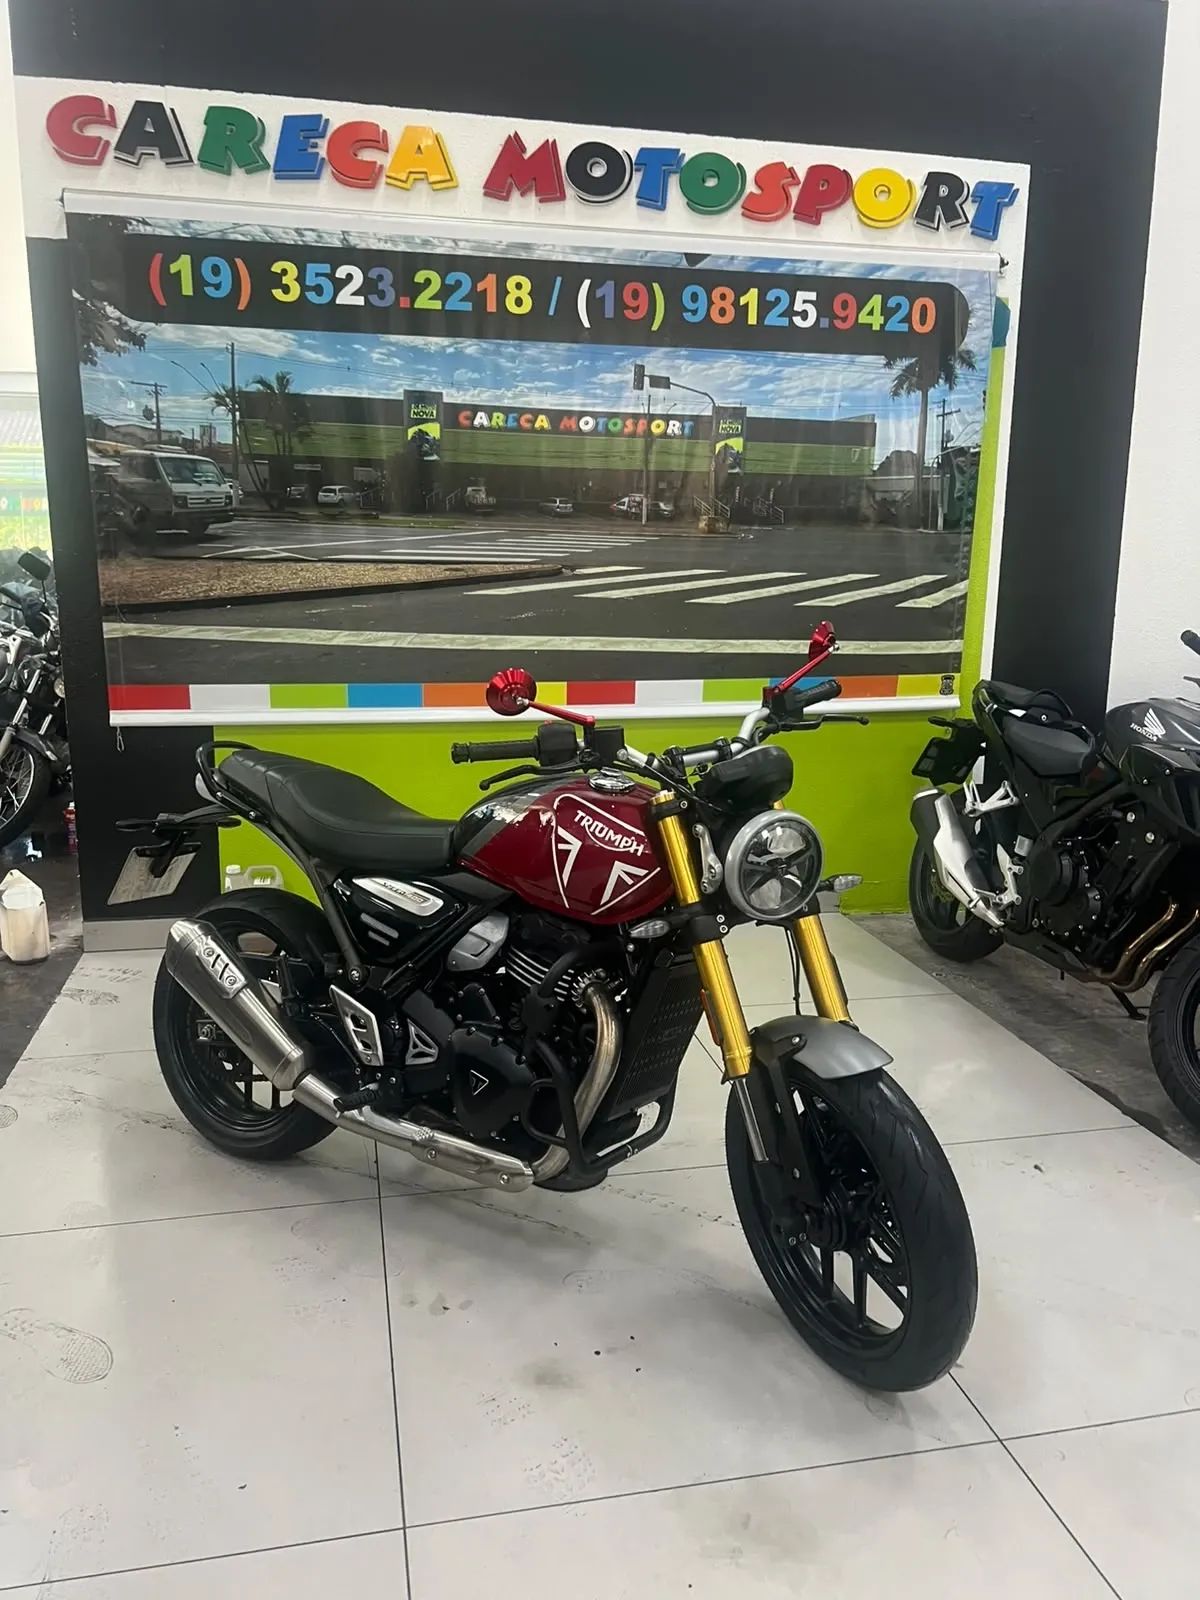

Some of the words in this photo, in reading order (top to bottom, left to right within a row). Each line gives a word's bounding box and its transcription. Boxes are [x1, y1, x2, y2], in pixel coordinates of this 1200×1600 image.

[46, 94, 459, 190] CARECA
[482, 130, 1020, 241] MOTOSPORT
[149, 252, 252, 310] (19)
[271, 260, 533, 315] 3523.2218
[577, 278, 665, 331] (19)
[682, 284, 937, 334] 98125.9420
[412, 410, 434, 418] NOVA
[458, 410, 551, 430] CARECA
[559, 415, 695, 436] MOTOSPORT
[1130, 723, 1158, 742] HONDA
[574, 810, 644, 856] TRIUMPH
